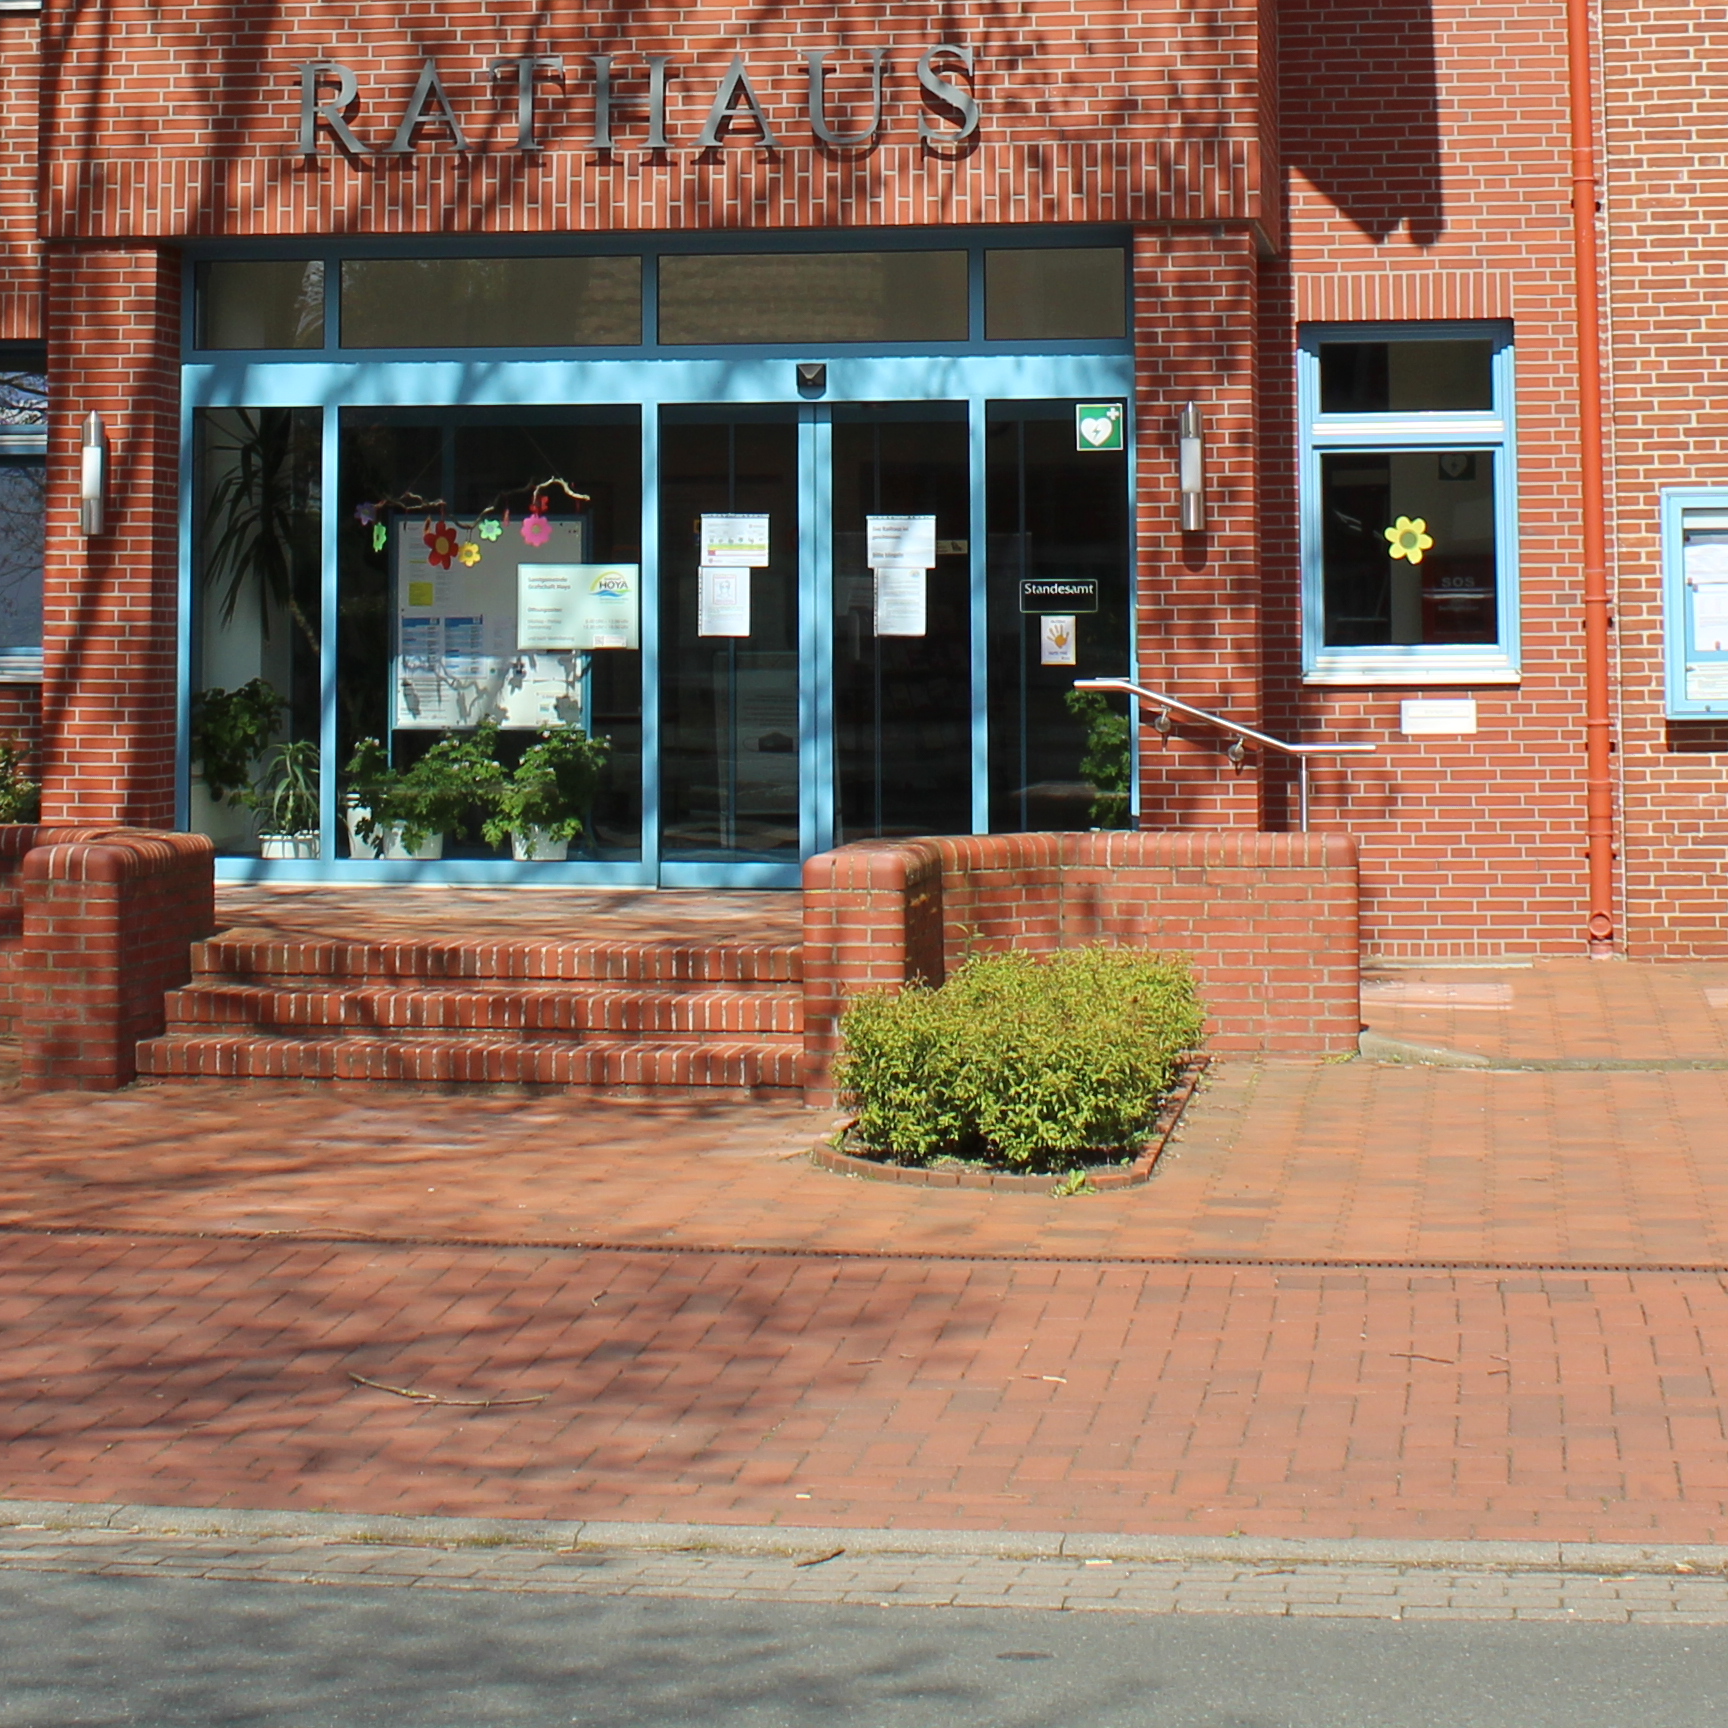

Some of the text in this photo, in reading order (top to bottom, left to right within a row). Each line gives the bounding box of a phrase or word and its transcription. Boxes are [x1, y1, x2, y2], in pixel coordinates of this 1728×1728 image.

[291, 43, 980, 153] RATHAUS
[599, 580, 628, 589] HOYA
[1441, 576, 1475, 588] SOS
[1024, 583, 1094, 594] Standesamt
